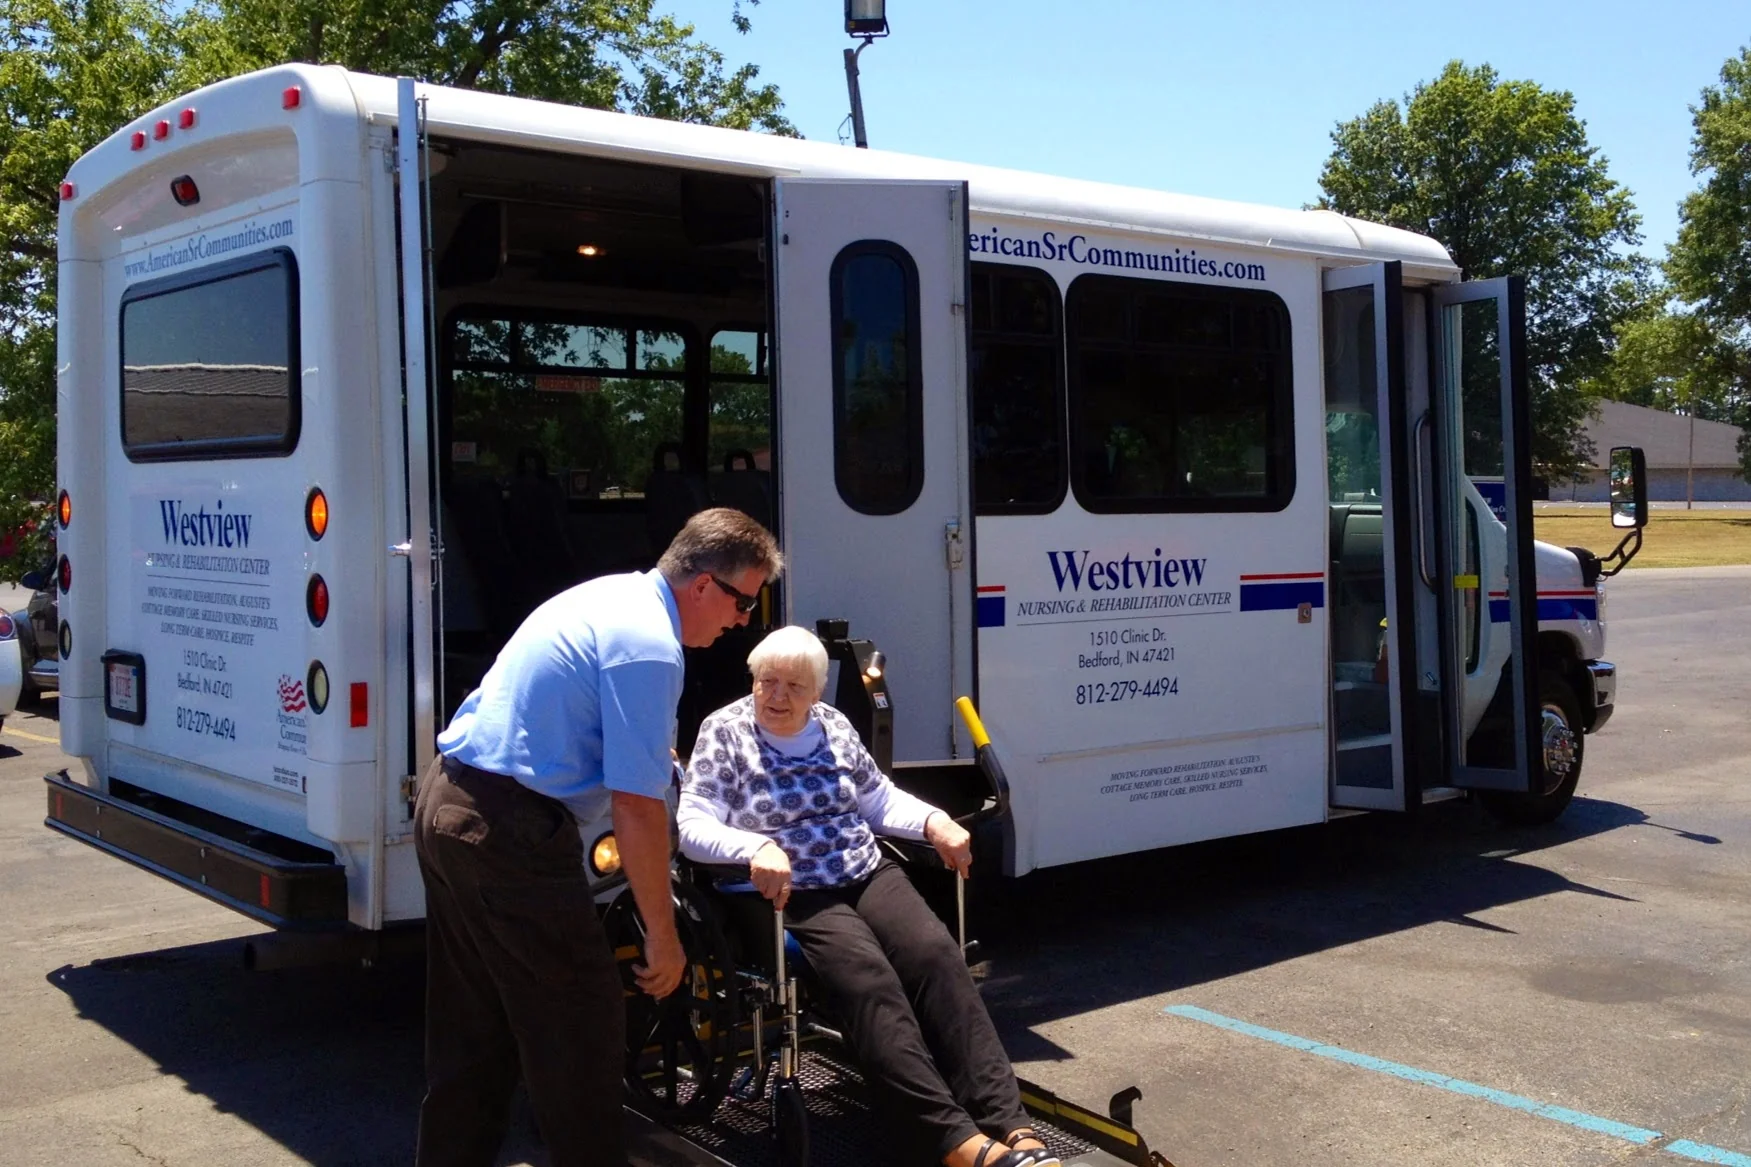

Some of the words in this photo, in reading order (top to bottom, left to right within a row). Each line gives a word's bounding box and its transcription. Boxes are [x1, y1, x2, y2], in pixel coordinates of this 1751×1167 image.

[125, 219, 293, 277] www.AmericanSrCommunities.com
[969, 228, 1265, 281] ericanSrCommunities.com
[160, 500, 252, 548] Westview
[183, 554, 239, 572] REHABILITATION
[240, 558, 270, 575] CENTER
[1047, 548, 1206, 592] Westview
[170, 588, 192, 600] FORWARD
[1017, 600, 1075, 616] NURSING
[1076, 601, 1086, 612] &
[1090, 594, 1186, 612] REHABILITATION
[1187, 592, 1231, 607] CENTER
[202, 610, 223, 622] SKILLED
[224, 612, 249, 626] NURSING
[161, 621, 175, 634] LONG
[231, 632, 254, 646] RESPITE
[1090, 630, 1117, 646] 1510
[1121, 628, 1150, 643] Clinic
[1152, 628, 1167, 641] Dr.
[184, 650, 198, 667] 1510
[201, 651, 217, 671] Clinic
[218, 656, 226, 672] Dr.
[1078, 653, 1123, 668] Bedford,
[1126, 651, 1139, 664] IN
[1142, 647, 1175, 662] 47421
[178, 673, 201, 693] Bedford,
[203, 678, 211, 693] IN
[212, 680, 232, 698] 47421
[1076, 677, 1178, 705] 812-279-4494
[177, 707, 236, 741] 812-279-4494
[1101, 783, 1132, 794] COTTAGE
[1133, 779, 1164, 790] MEMORY
[1185, 773, 1209, 783] SKILLED
[1211, 768, 1238, 779] NURSING
[1111, 771, 1139, 781] MOVING
[1141, 767, 1173, 778] FORWARD
[1131, 793, 1149, 802] LONG
[1151, 790, 1168, 799] TERM
[1219, 779, 1242, 789] RESPITE
